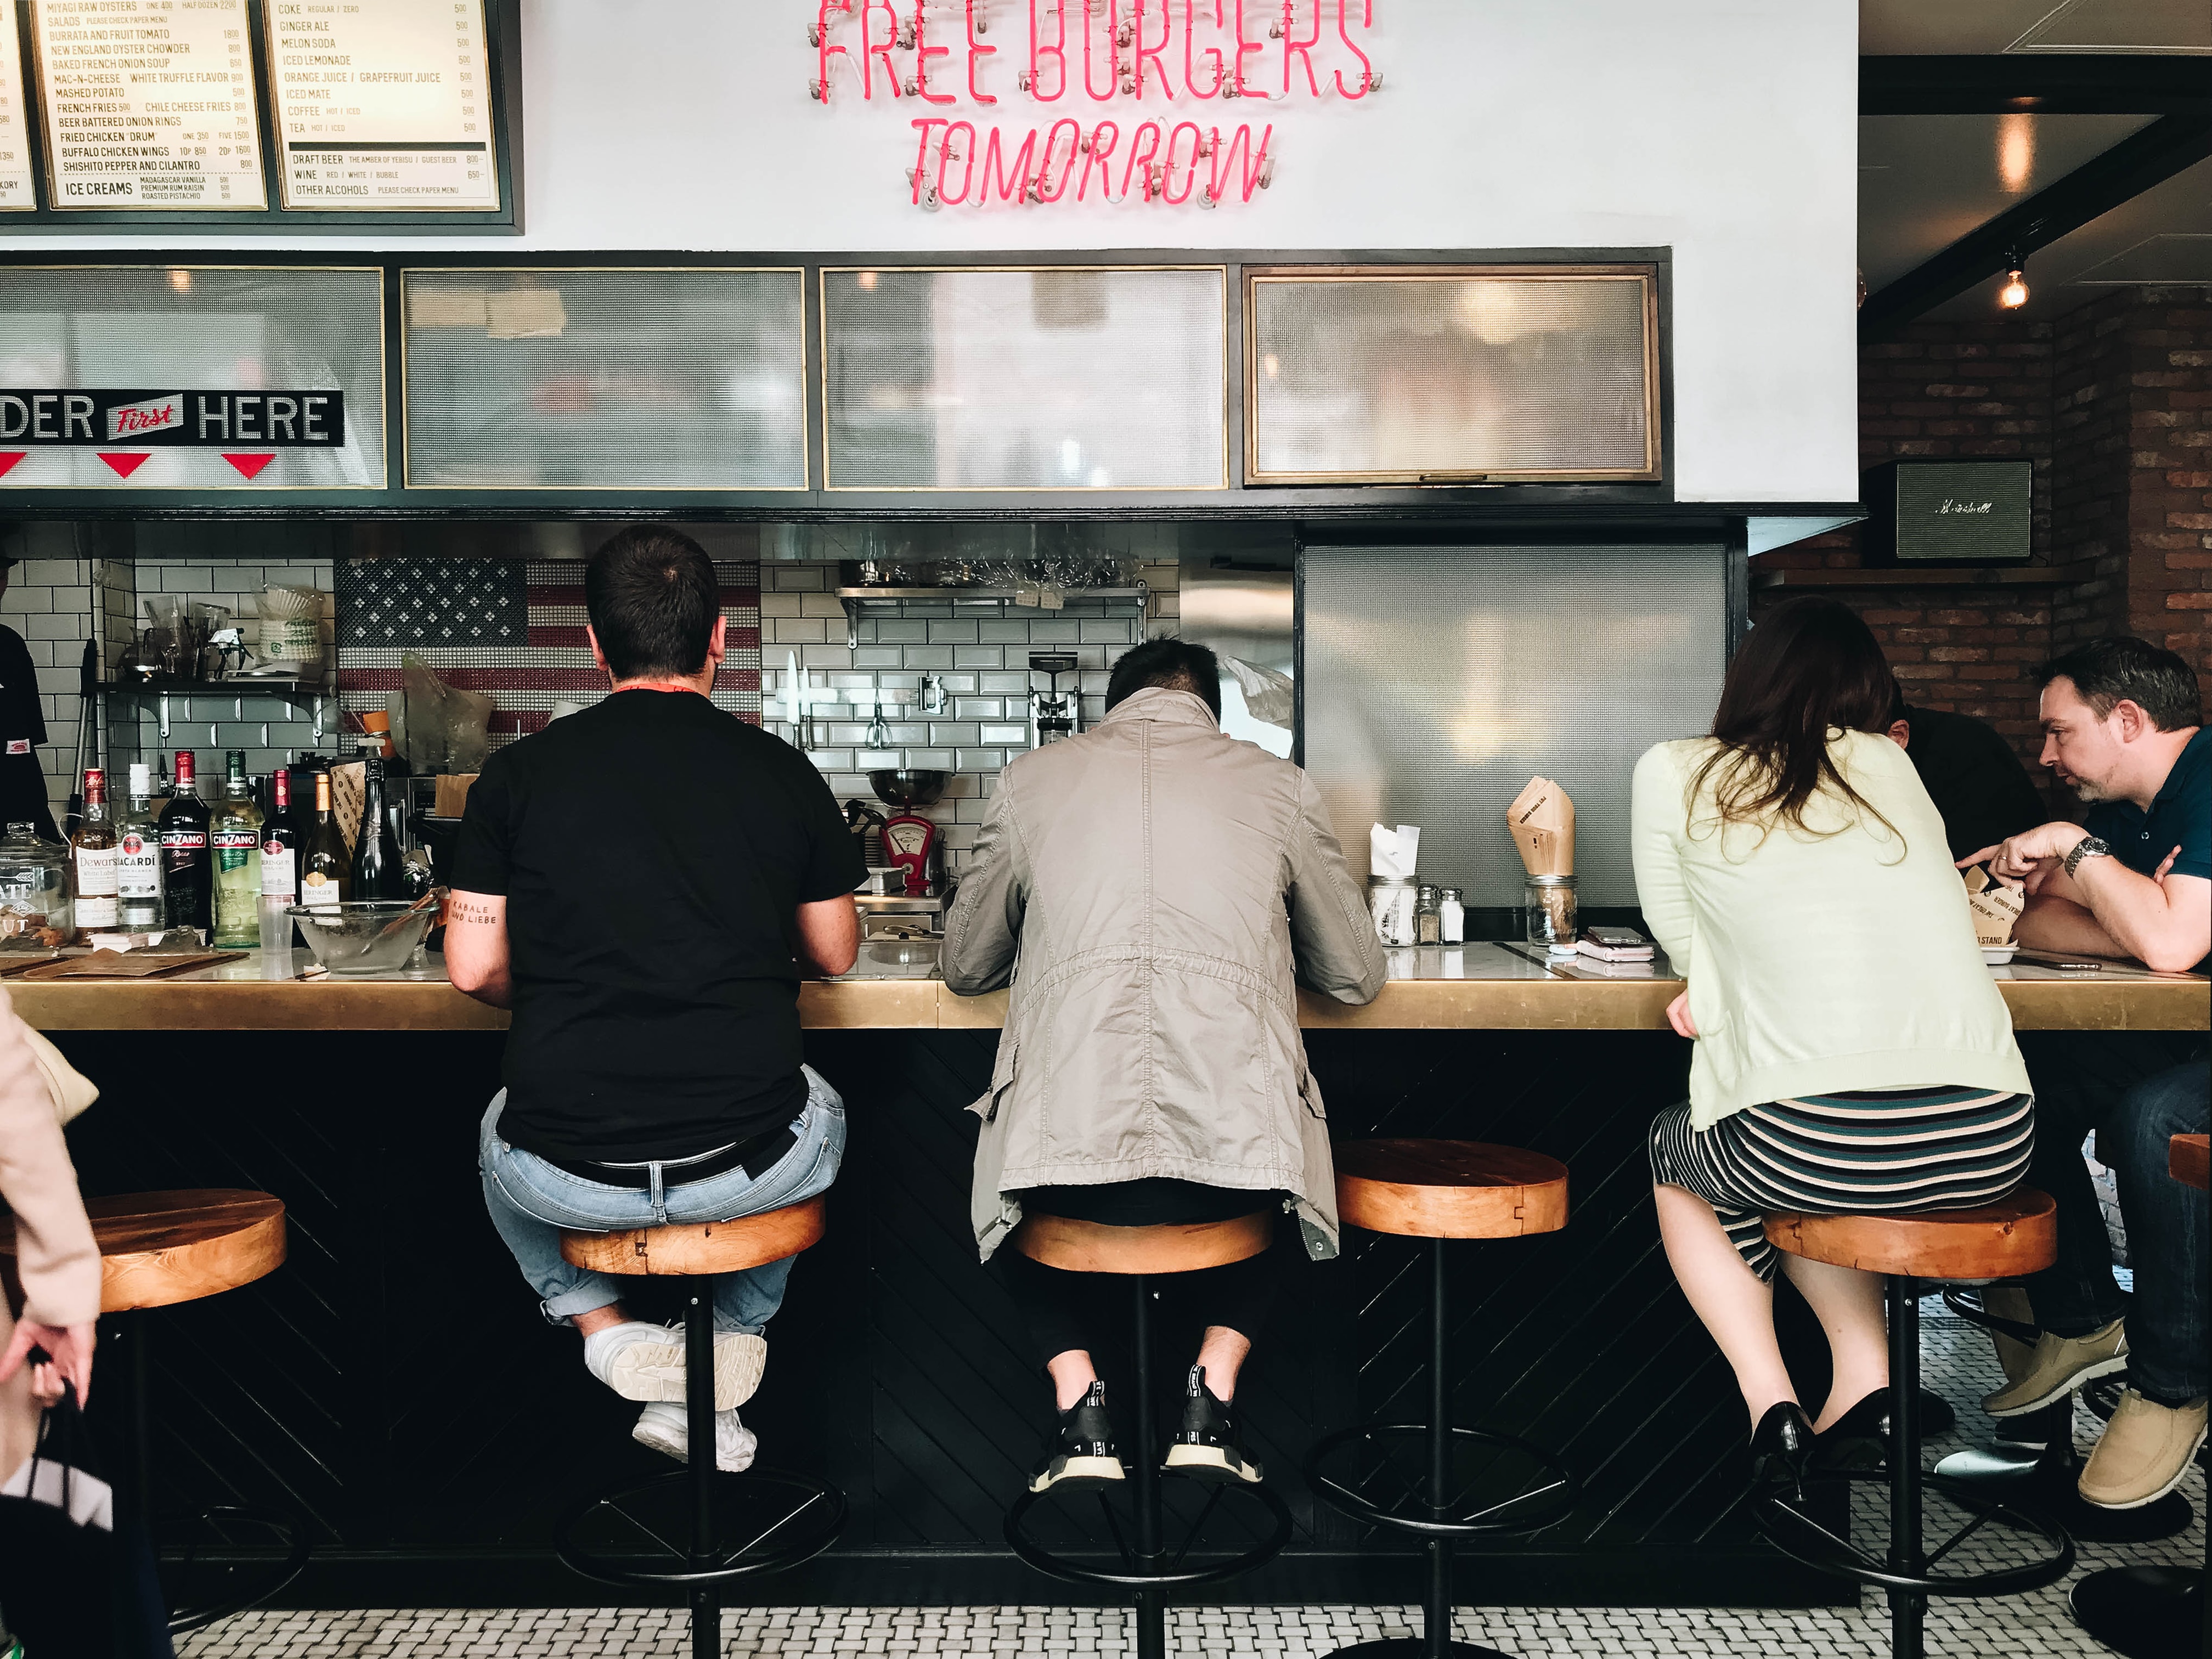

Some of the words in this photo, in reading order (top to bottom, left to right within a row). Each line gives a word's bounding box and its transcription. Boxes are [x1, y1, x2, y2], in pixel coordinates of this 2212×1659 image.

[47, 2, 76, 13] MIYAGI
[78, 2, 97, 12] RAW
[100, 2, 137, 12] OYSTERS
[221, 1, 236, 9] 2200
[279, 4, 301, 14] COKE
[454, 4, 466, 13] 500
[48, 16, 80, 26] SALADS
[280, 21, 312, 31] GINGER
[314, 21, 329, 31] ALE
[456, 21, 468, 30] 500
[49, 31, 89, 41] BURRATA
[91, 30, 108, 40] AND
[110, 30, 134, 40] FRUIT
[136, 29, 170, 40] TOMATO
[224, 30, 239, 38] 1800
[281, 38, 311, 48] MELON
[312, 38, 336, 48] SODA
[457, 38, 469, 47] 500
[50, 46, 70, 55] NEW
[72, 44, 111, 55] ENGLAND
[113, 44, 145, 54] OYSTER
[147, 43, 190, 53] CHOWDER
[228, 44, 240, 53] 800
[819, 0, 997, 104] FREE
[1030, 0, 1373, 101] BURGERS
[52, 60, 81, 70] BAKED
[82, 59, 116, 69] FRENCH
[119, 59, 145, 69] ONION
[147, 58, 170, 68] SOUP
[230, 59, 241, 67] 650
[283, 55, 302, 65] ICED
[305, 55, 351, 65] LEMONADE
[459, 55, 471, 64] 500
[54, 74, 121, 84] MAC-N-CHEESE
[129, 73, 157, 83] WHITE
[159, 72, 194, 82] TRUFFLE
[196, 72, 229, 82] FLAVOR
[231, 73, 243, 82] 900
[284, 72, 319, 82] ORANGE
[321, 72, 347, 82] JUICE
[360, 72, 413, 82] GRAPEFRUIT
[415, 73, 441, 82] JUICE
[460, 72, 472, 82] 500
[55, 88, 91, 98] MASHED
[93, 88, 125, 97] POTATO
[233, 88, 245, 97] 500
[286, 89, 306, 99] ICED
[308, 89, 331, 99] MATE
[461, 89, 473, 98] 500
[57, 103, 91, 113] FRENCH
[93, 103, 117, 112] FRIES
[119, 103, 131, 112] 500
[145, 102, 170, 112] CHILE
[172, 102, 205, 111] CHEESE
[206, 102, 231, 111] FRIES
[234, 102, 246, 111] 800
[288, 106, 320, 116] COFFEE
[462, 106, 475, 115] 500
[59, 117, 80, 127] BEER
[82, 117, 124, 127] BATTERED
[126, 117, 153, 126] ONION
[155, 116, 182, 126] RINGS
[235, 117, 247, 126] 750
[290, 123, 305, 133] TEA
[464, 123, 476, 132] 500
[60, 132, 85, 143] FRIED
[87, 132, 125, 142] CHICKEN
[197, 132, 209, 140] 350
[234, 131, 250, 140] 1500
[62, 147, 99, 157] BUFFALO
[101, 147, 139, 156] CHICKEN
[140, 146, 170, 156] WINGS
[195, 146, 206, 155] 850
[235, 145, 251, 155] 1600
[293, 155, 319, 164] DRAFT
[322, 155, 343, 164] BEER
[911, 117, 1273, 205] TOMORROW
[64, 162, 103, 172] SHISHITO
[105, 161, 137, 171] PEPPER
[139, 161, 157, 171] AND
[159, 161, 200, 170] CILANTRO
[240, 160, 252, 168] 800
[294, 170, 317, 179] WINE
[66, 183, 83, 195] ICE
[86, 182, 133, 195] CREAMS
[296, 185, 323, 195] OTHER
[325, 185, 369, 195] ALCOHOLS
[0, 395, 94, 438] DER
[117, 404, 173, 433] First
[198, 396, 328, 440] HERE
[161, 834, 203, 845] CINZANO
[213, 834, 255, 845] CINZANO
